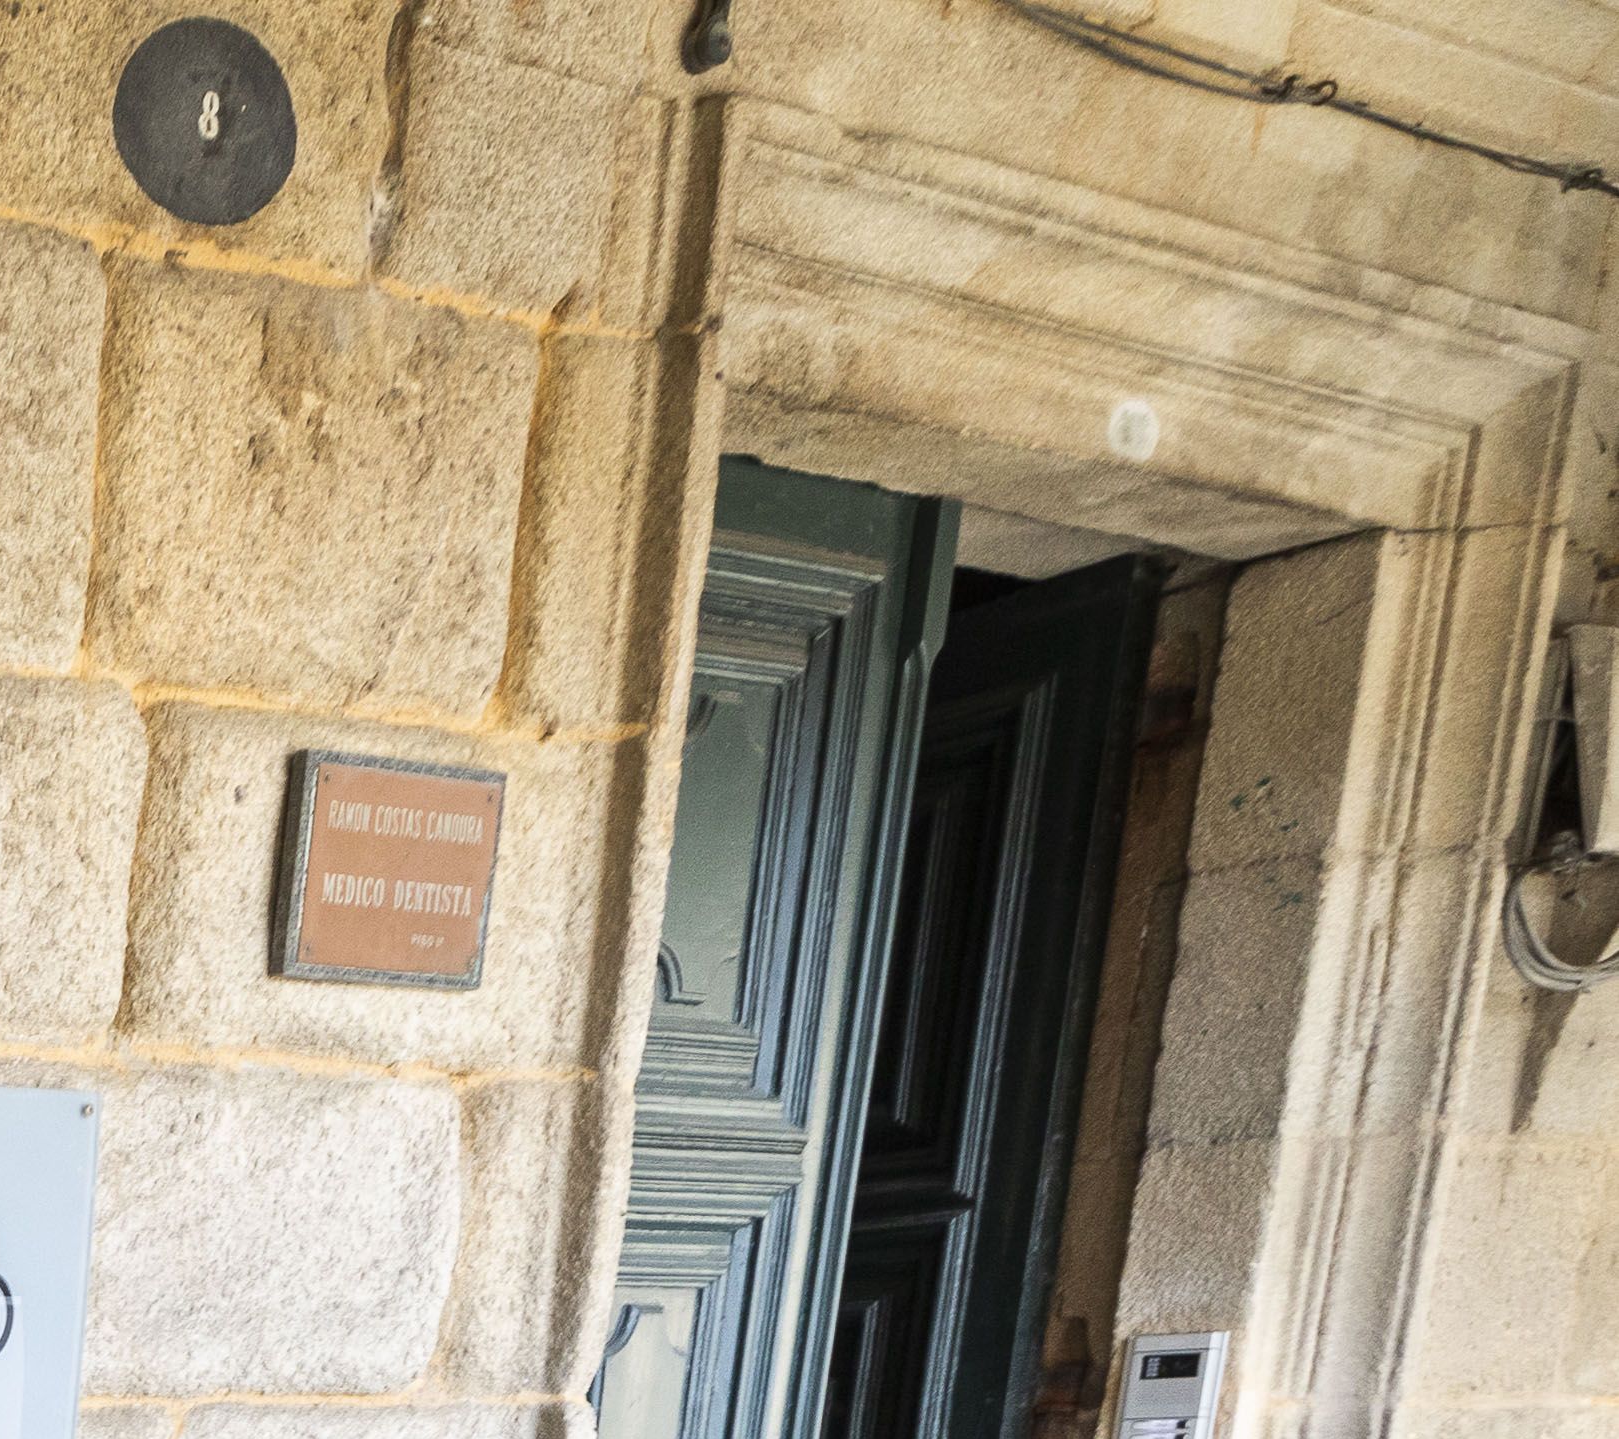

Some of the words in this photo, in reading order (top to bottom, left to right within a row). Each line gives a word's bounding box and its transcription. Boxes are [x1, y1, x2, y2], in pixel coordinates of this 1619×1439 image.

[198, 90, 220, 140] 8
[327, 799, 372, 833] RAMON
[374, 804, 423, 840] COSTAS
[321, 872, 385, 909] MEDICO
[393, 879, 472, 917] DENTISTA
